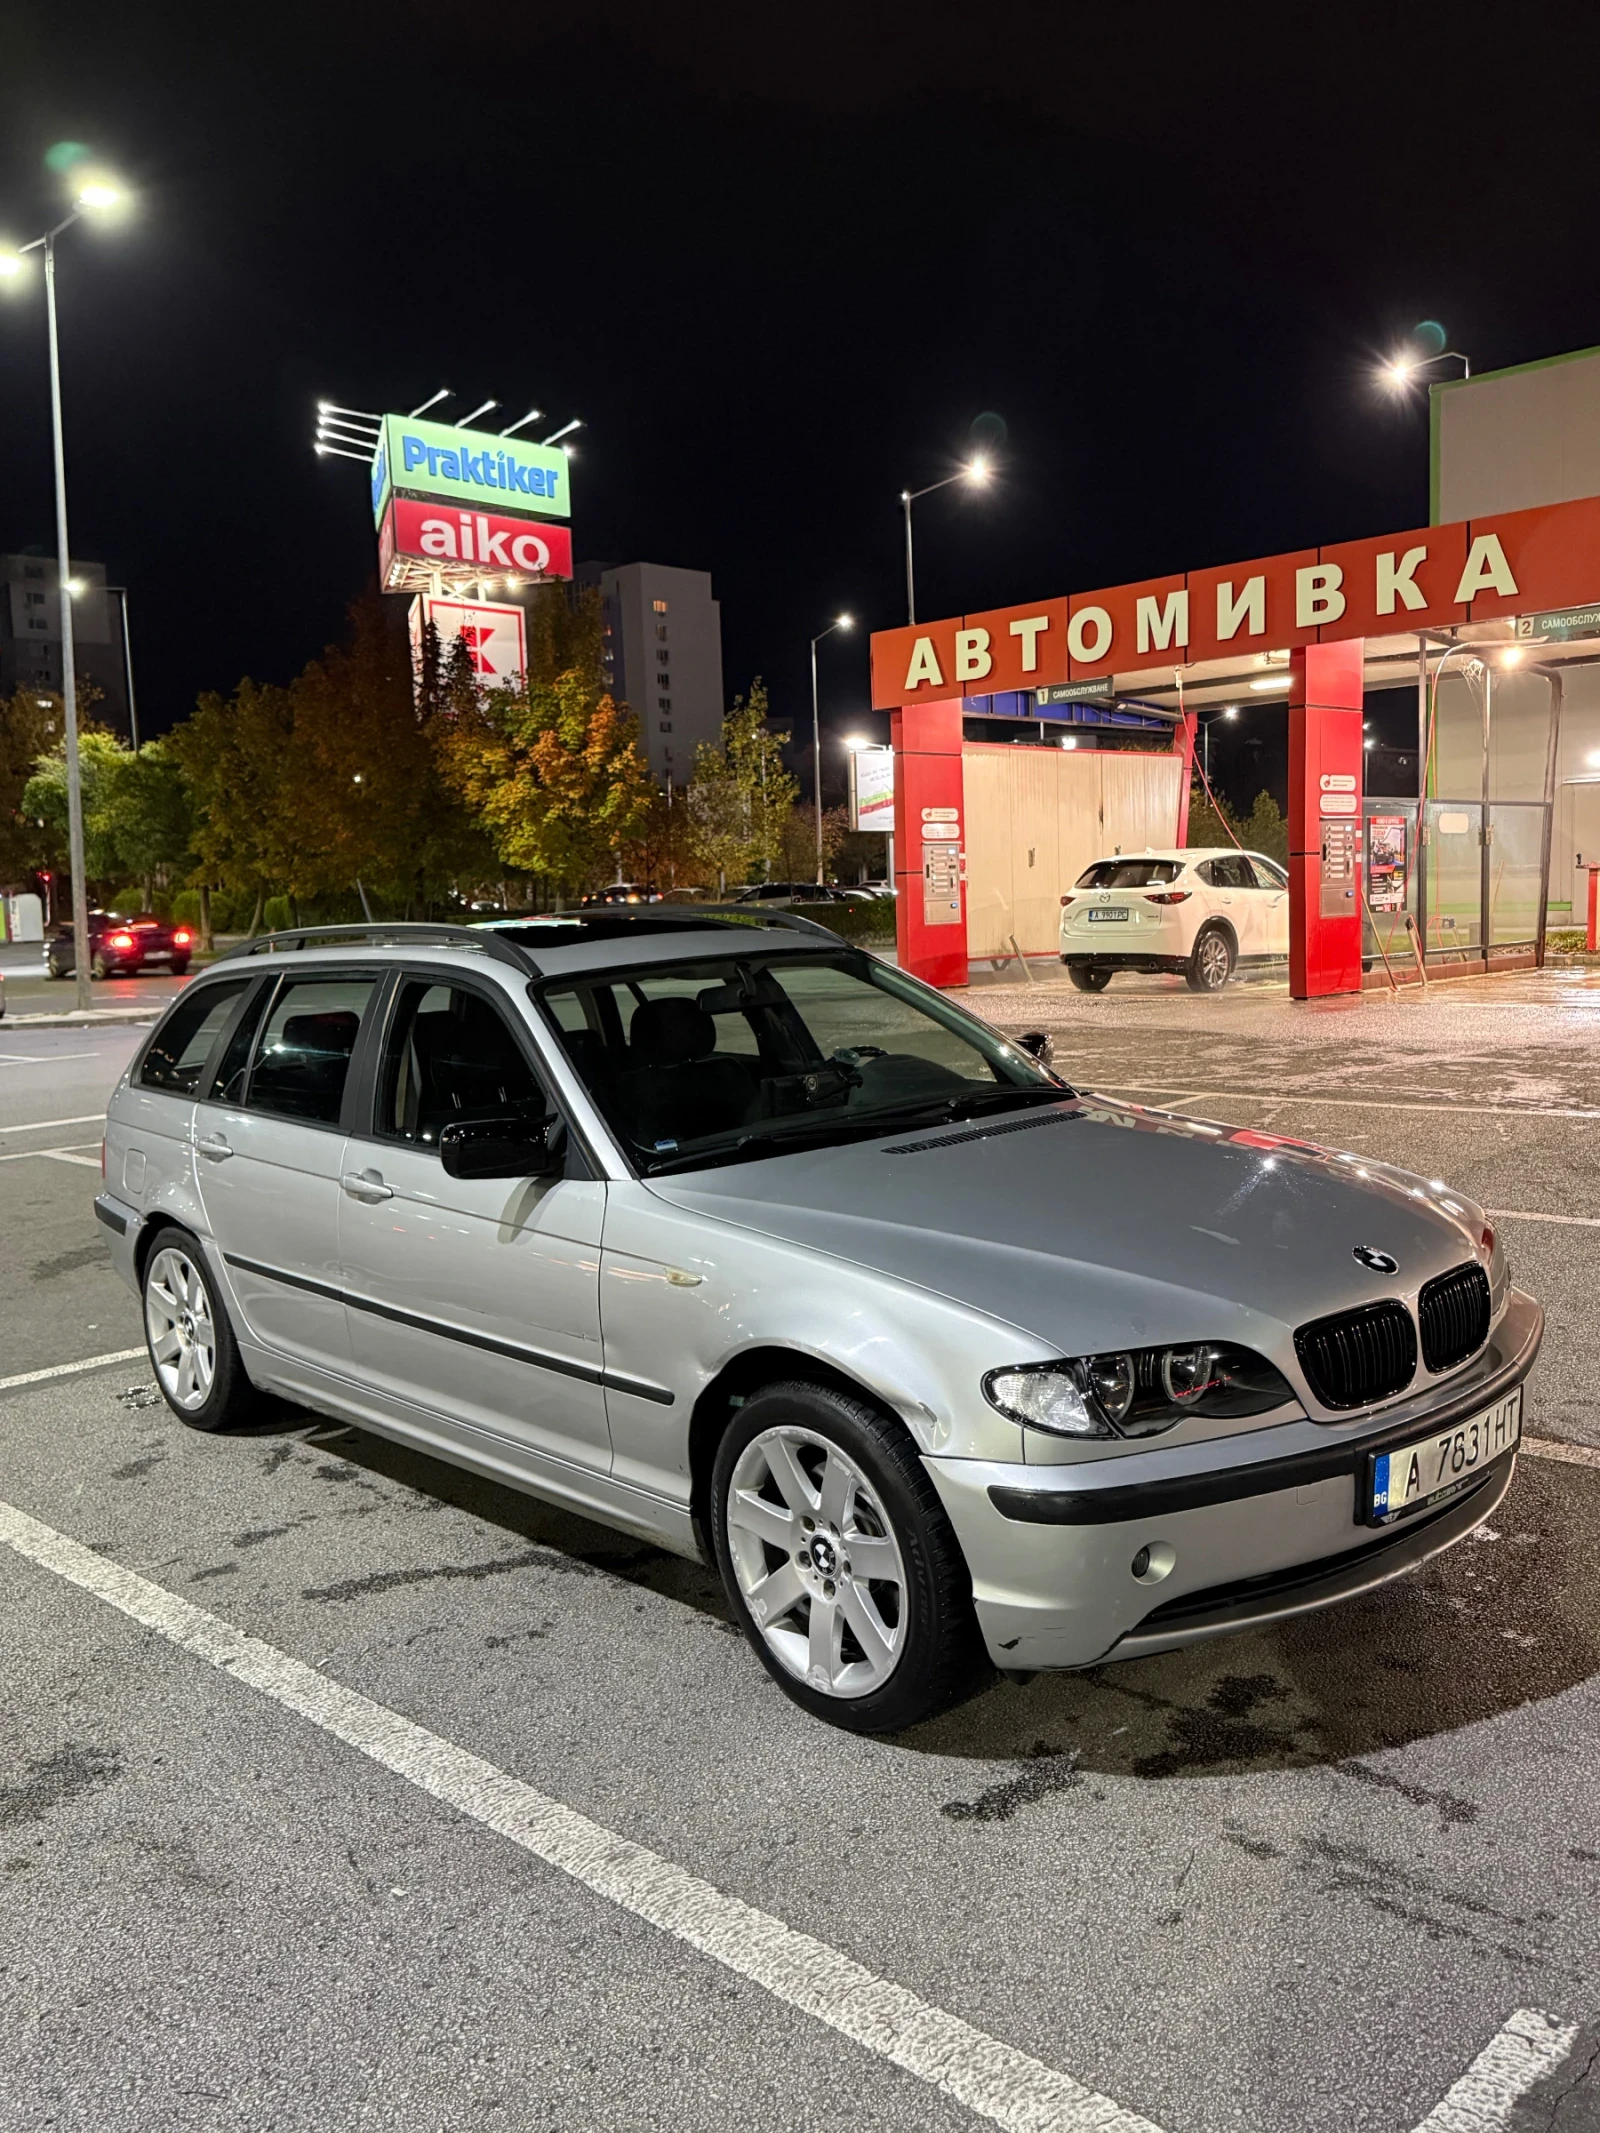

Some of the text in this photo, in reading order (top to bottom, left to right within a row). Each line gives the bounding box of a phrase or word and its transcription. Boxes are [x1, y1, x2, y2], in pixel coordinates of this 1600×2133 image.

[403, 435, 558, 497] Praktiker
[420, 514, 549, 571] aiko
[904, 533, 1519, 690] АВТОМИВКА
[1522, 620, 1531, 634] 2
[1041, 683, 1108, 702] 1 САМООБСЛУЖВАНЕ
[1374, 1491, 1387, 1508] BG
